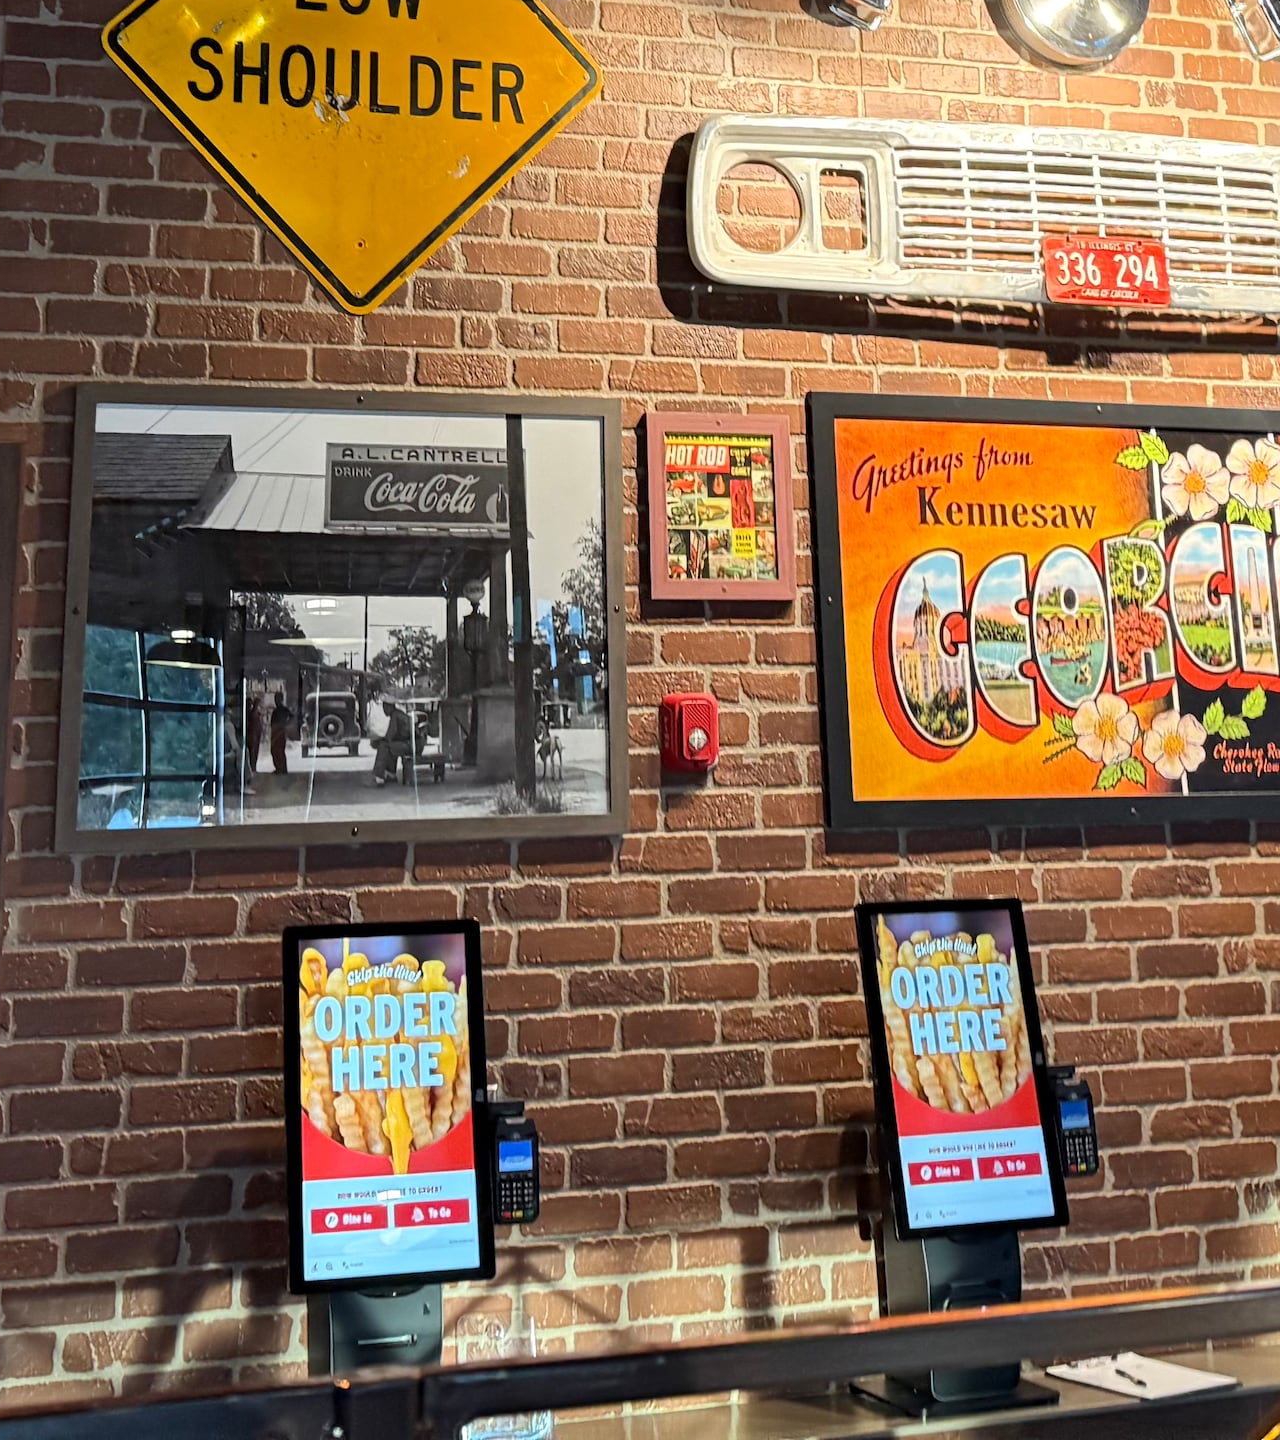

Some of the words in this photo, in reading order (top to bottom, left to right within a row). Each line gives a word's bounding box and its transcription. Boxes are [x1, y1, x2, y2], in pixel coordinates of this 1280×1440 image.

[187, 36, 524, 124] SHOULDER
[1055, 251, 1101, 287] 336
[1114, 253, 1159, 290] 294
[334, 466, 373, 478] DRINK
[665, 444, 695, 466] HOT
[696, 445, 727, 467] ROD
[852, 446, 964, 514] Greetings
[973, 437, 1035, 482] from
[364, 472, 480, 514] Coca-Cola
[918, 486, 1097, 530] Kennesaw
[890, 962, 1013, 1009] ORDER
[314, 991, 457, 1041] ORDER
[909, 1009, 1007, 1056] HERE
[331, 1041, 444, 1092] HERE
[428, 1207, 439, 1219] To
[439, 1206, 452, 1219] Go
